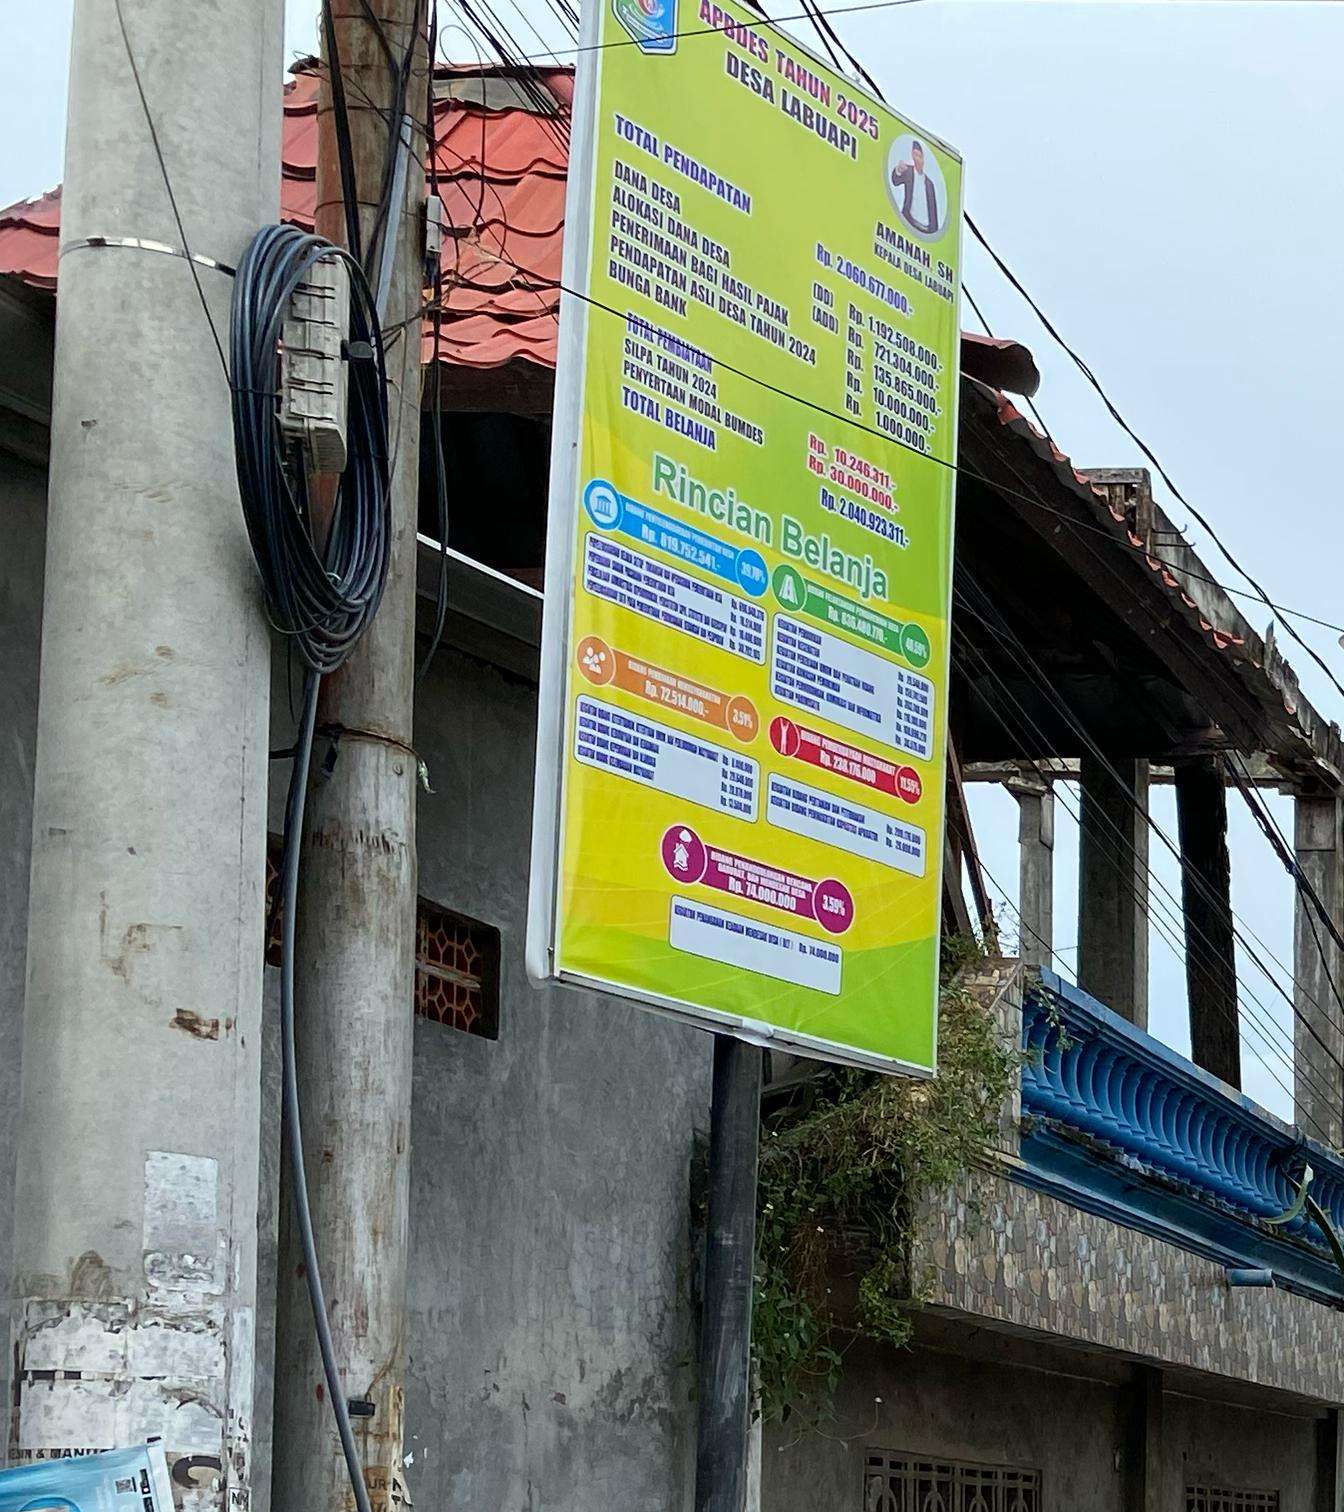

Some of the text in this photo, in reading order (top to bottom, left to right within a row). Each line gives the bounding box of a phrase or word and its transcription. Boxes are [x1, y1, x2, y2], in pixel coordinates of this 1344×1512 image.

[699, 0, 879, 141] APBDES TAHUN 2025
[726, 51, 857, 160] DESA LABUAPI
[614, 160, 681, 214] DANA DESA
[615, 114, 751, 214] TOTAL PENDAPATAN
[612, 185, 730, 268] ALOKASI DANA DESA
[816, 243, 833, 268] Rp.
[609, 259, 687, 317] BUNGA BANK
[610, 235, 816, 366] PENDAPATAN ASLI DESA TAHUN 2024
[611, 209, 789, 326] PENERIMAAN BAGI HASIL PAJAK
[937, 261, 954, 284] SH
[626, 312, 655, 341] TOTAL
[849, 303, 865, 327] Rp.
[623, 360, 764, 445] PENYERTAAN MODAL BUMDES
[624, 338, 717, 400] SILPA TAHUN 2024
[622, 386, 716, 450] TOTAL BELANJA
[653, 453, 772, 545] Rincian
[782, 517, 887, 599] Belanja
